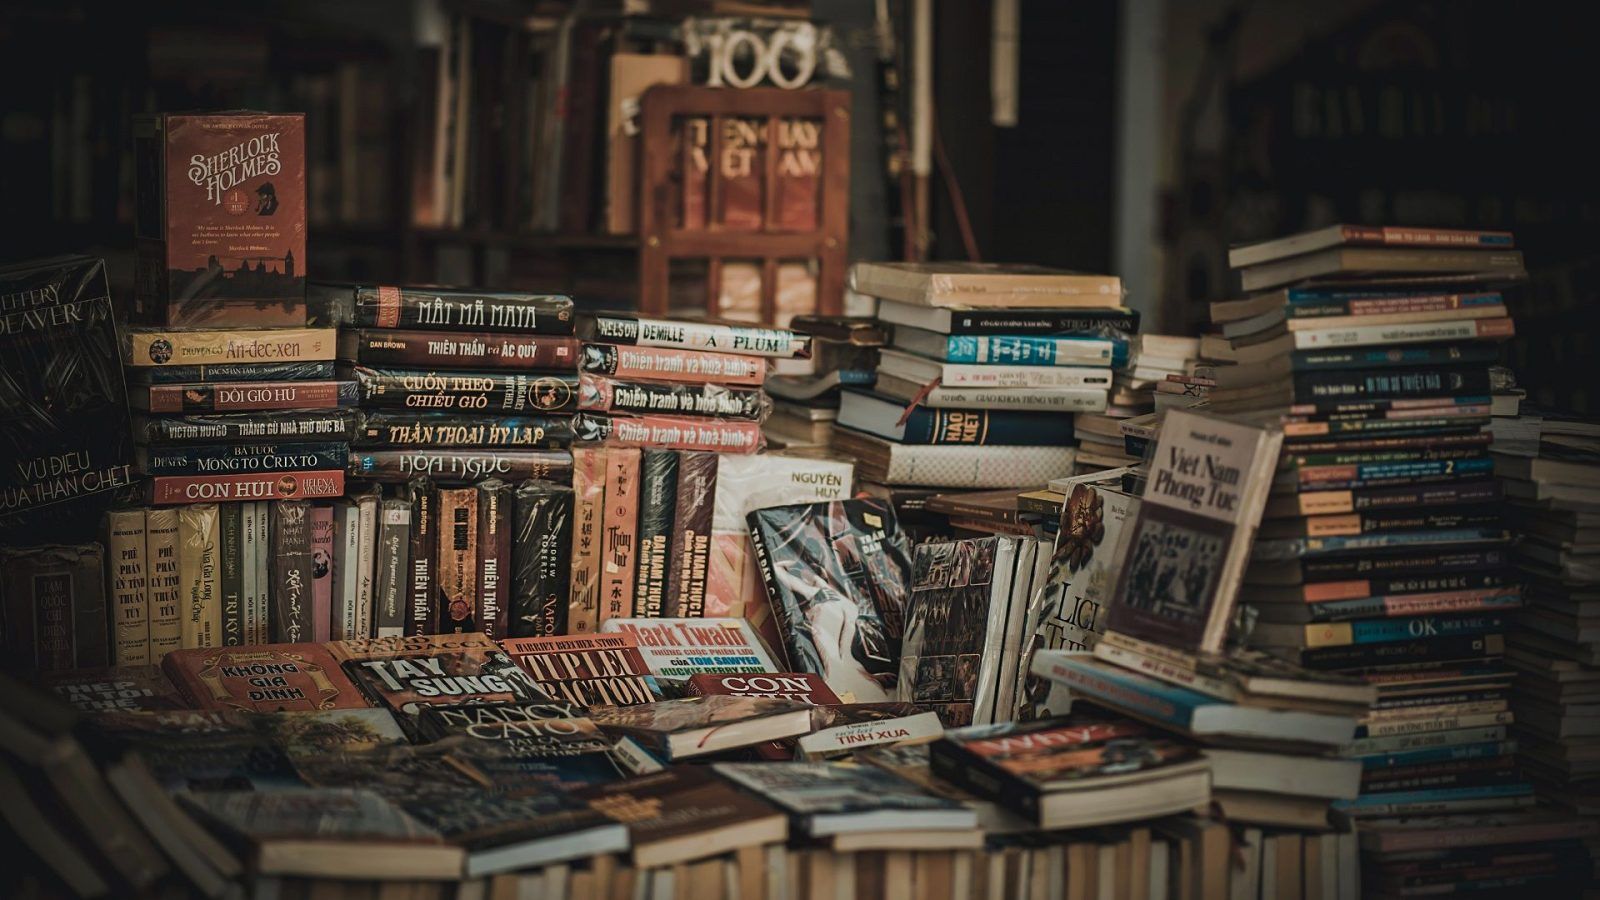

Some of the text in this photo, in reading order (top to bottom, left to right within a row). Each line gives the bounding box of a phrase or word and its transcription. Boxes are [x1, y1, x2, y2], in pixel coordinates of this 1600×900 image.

[706, 28, 817, 89] 100
[188, 133, 281, 185] SHERLOCK
[207, 152, 281, 206] HOLMES
[0, 283, 61, 312] EFFERY
[490, 304, 537, 329] MAYA
[600, 318, 685, 343] NELSON DEMILLE
[384, 341, 406, 350] BROWN
[733, 335, 779, 352] PLUM
[655, 353, 684, 372] tranh
[451, 376, 494, 391] THEO
[458, 394, 488, 409] GIÓ
[649, 392, 679, 409] tranh
[169, 425, 198, 439] VICTOR
[652, 427, 681, 443] tranh
[1202, 454, 1240, 485] Nam
[186, 482, 231, 499] CON
[814, 488, 842, 498] HUY
[540, 534, 548, 580] ROBERTS
[549, 534, 557, 578] ANDREW
[650, 555, 665, 579] NAM
[692, 555, 706, 579] NAM
[618, 623, 748, 647] Mark Twain
[1408, 617, 1438, 638] OK
[515, 641, 555, 653] HARRIET
[594, 637, 628, 648] STOWE
[689, 657, 713, 666] TOM
[714, 656, 760, 665] SAWYER
[248, 677, 288, 688] GIA
[361, 657, 447, 691] TAY
[721, 677, 814, 692] CON
[439, 703, 575, 726] NANCY
[466, 720, 580, 741] CATO
